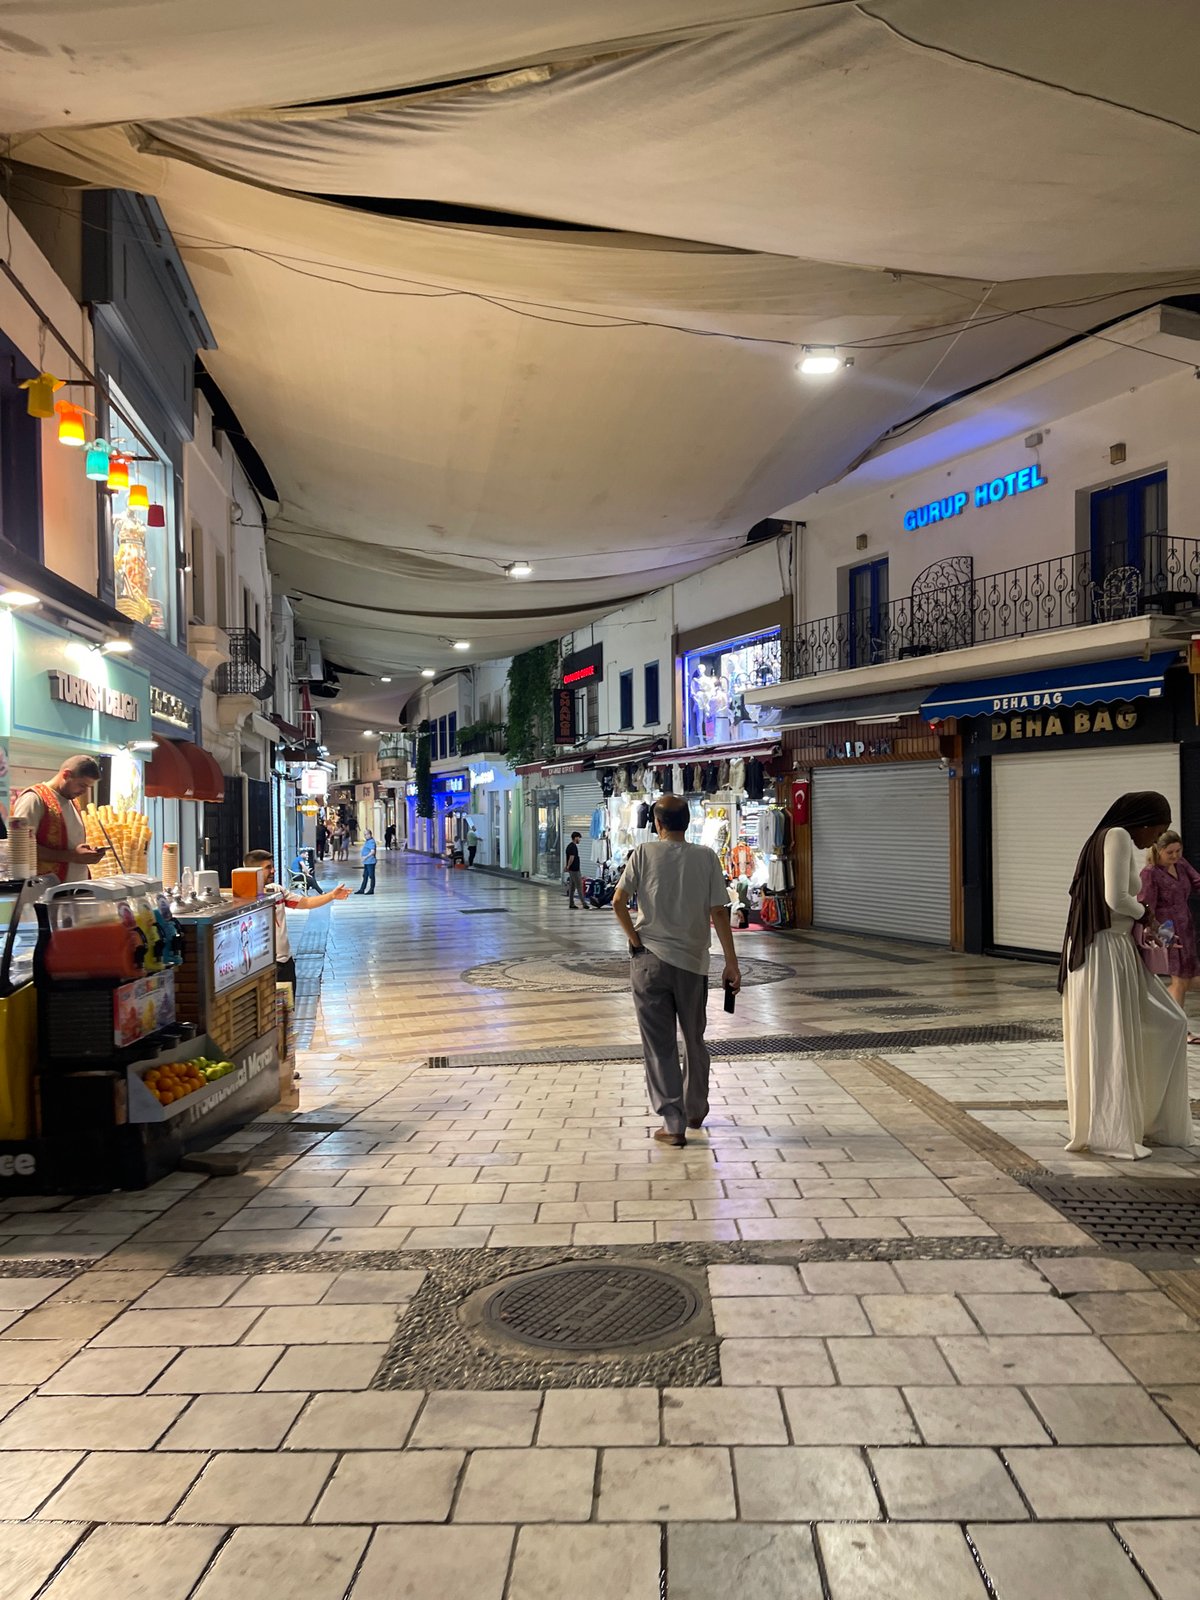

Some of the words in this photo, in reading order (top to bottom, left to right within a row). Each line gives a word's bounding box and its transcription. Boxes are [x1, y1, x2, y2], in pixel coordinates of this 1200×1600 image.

[903, 492, 969, 531] GURUP
[974, 464, 1047, 508] HOTEL
[55, 669, 103, 712] TURKISH
[993, 697, 1028, 711] DEHA
[1033, 692, 1063, 706] BAG
[559, 690, 571, 736] CHANGE
[991, 712, 1064, 741] DEHA
[1074, 704, 1138, 734] BAG
